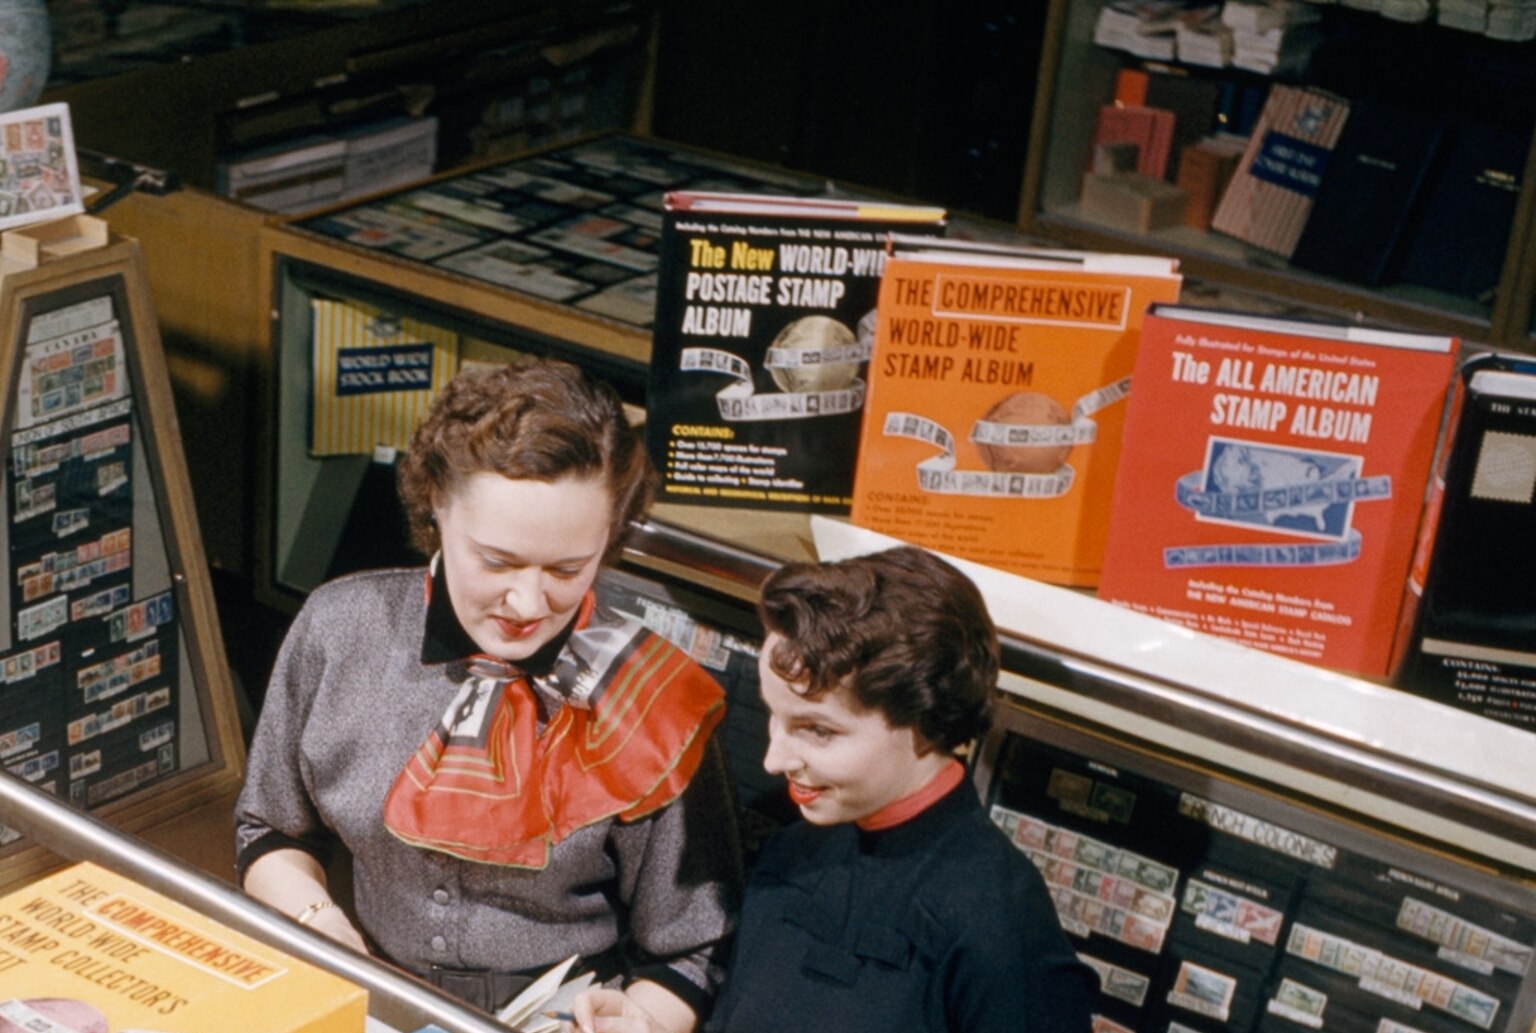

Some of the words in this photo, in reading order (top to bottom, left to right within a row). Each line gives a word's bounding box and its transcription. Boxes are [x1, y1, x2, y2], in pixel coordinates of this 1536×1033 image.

[690, 239, 725, 269] The
[731, 242, 774, 272] New
[686, 272, 772, 304] POSTAGE
[777, 277, 845, 309] STAMP
[894, 277, 933, 307] THE
[941, 280, 1123, 322] COMPREHENSIVE
[682, 306, 751, 337] ALBUM
[888, 316, 1021, 353] WORLD-WIDE
[44, 331, 98, 353] CANADA
[1175, 334, 1196, 348] Fully
[1198, 337, 1240, 351] Illustrated
[1242, 342, 1254, 353] for
[1257, 344, 1288, 359] Stamps
[1302, 350, 1316, 361] the
[1318, 352, 1347, 364] United
[1349, 355, 1377, 368] States
[340, 354, 391, 370] WORLD
[393, 351, 429, 367] WIDE
[341, 371, 384, 387] STOCK
[387, 368, 428, 384] BOOK
[884, 353, 954, 382] STAMP
[960, 358, 1034, 387] ALBUM
[1171, 351, 1211, 385] The
[1216, 357, 1254, 391] ALL
[1260, 363, 1380, 407] AMERICAN
[1210, 393, 1288, 432] STAMP
[1290, 404, 1372, 444] ALBUM
[1491, 403, 1511, 414] THE
[672, 424, 735, 439] CONTAINS:
[1186, 588, 1203, 600] THE
[1205, 591, 1226, 604] NEW
[1278, 603, 1308, 618] STAMP
[1187, 579, 1224, 595] Including
[1226, 584, 1240, 595] the
[1314, 598, 1334, 611] from
[1251, 817, 1338, 868] COLONIES
[21, 895, 151, 965] WORLD-WIDE
[59, 879, 110, 907] THE
[99, 897, 279, 985] COMPREHENSIVE
[50, 949, 189, 1016] COLLECTOR'S
